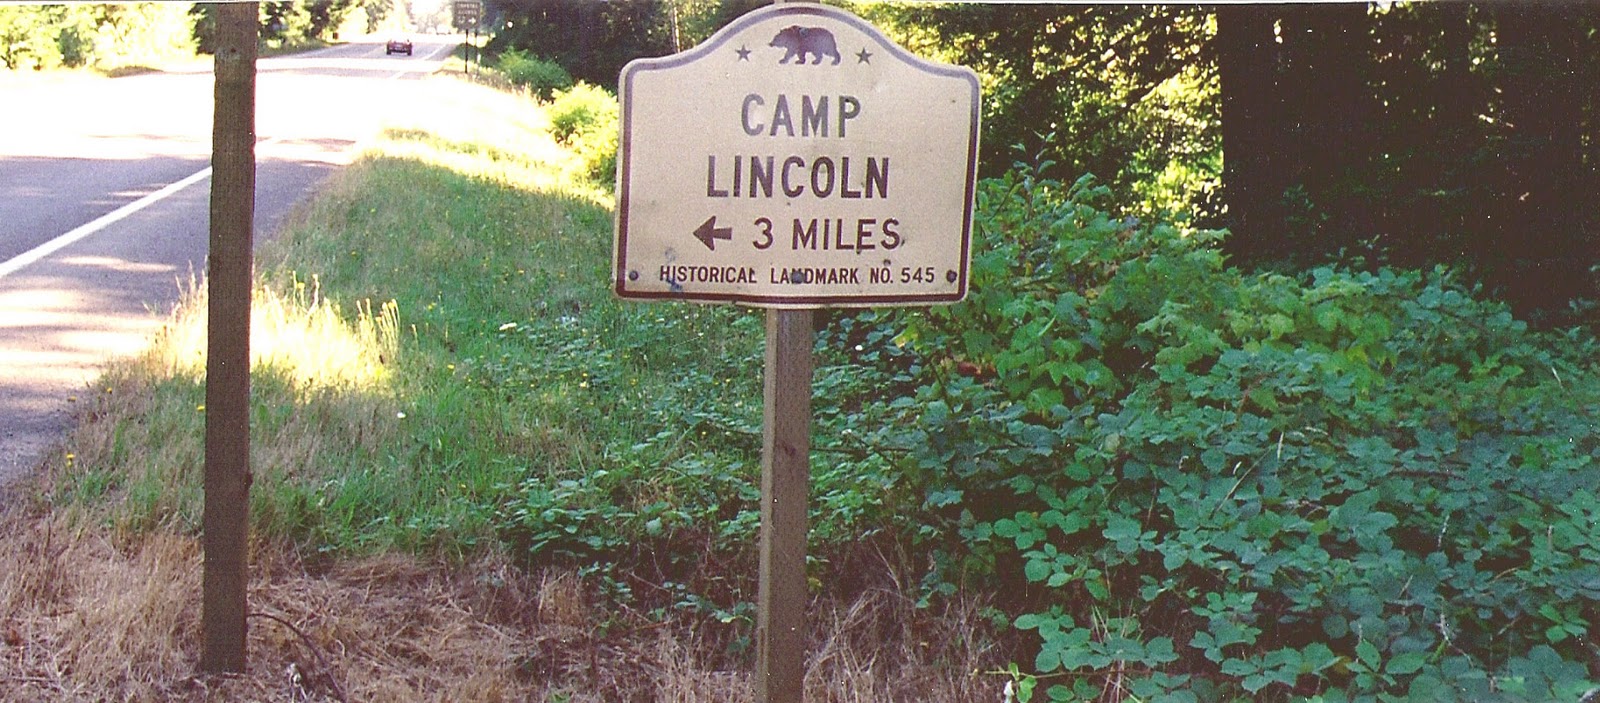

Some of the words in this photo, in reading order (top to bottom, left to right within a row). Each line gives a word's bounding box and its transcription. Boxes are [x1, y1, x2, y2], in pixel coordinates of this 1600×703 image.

[740, 93, 862, 138] CAMP
[706, 155, 890, 199] LINCOLN
[752, 217, 774, 250] 3
[791, 218, 902, 251] MILES
[659, 265, 758, 284] HISTORICAL
[869, 267, 894, 284] NO.
[900, 267, 935, 284] 545
